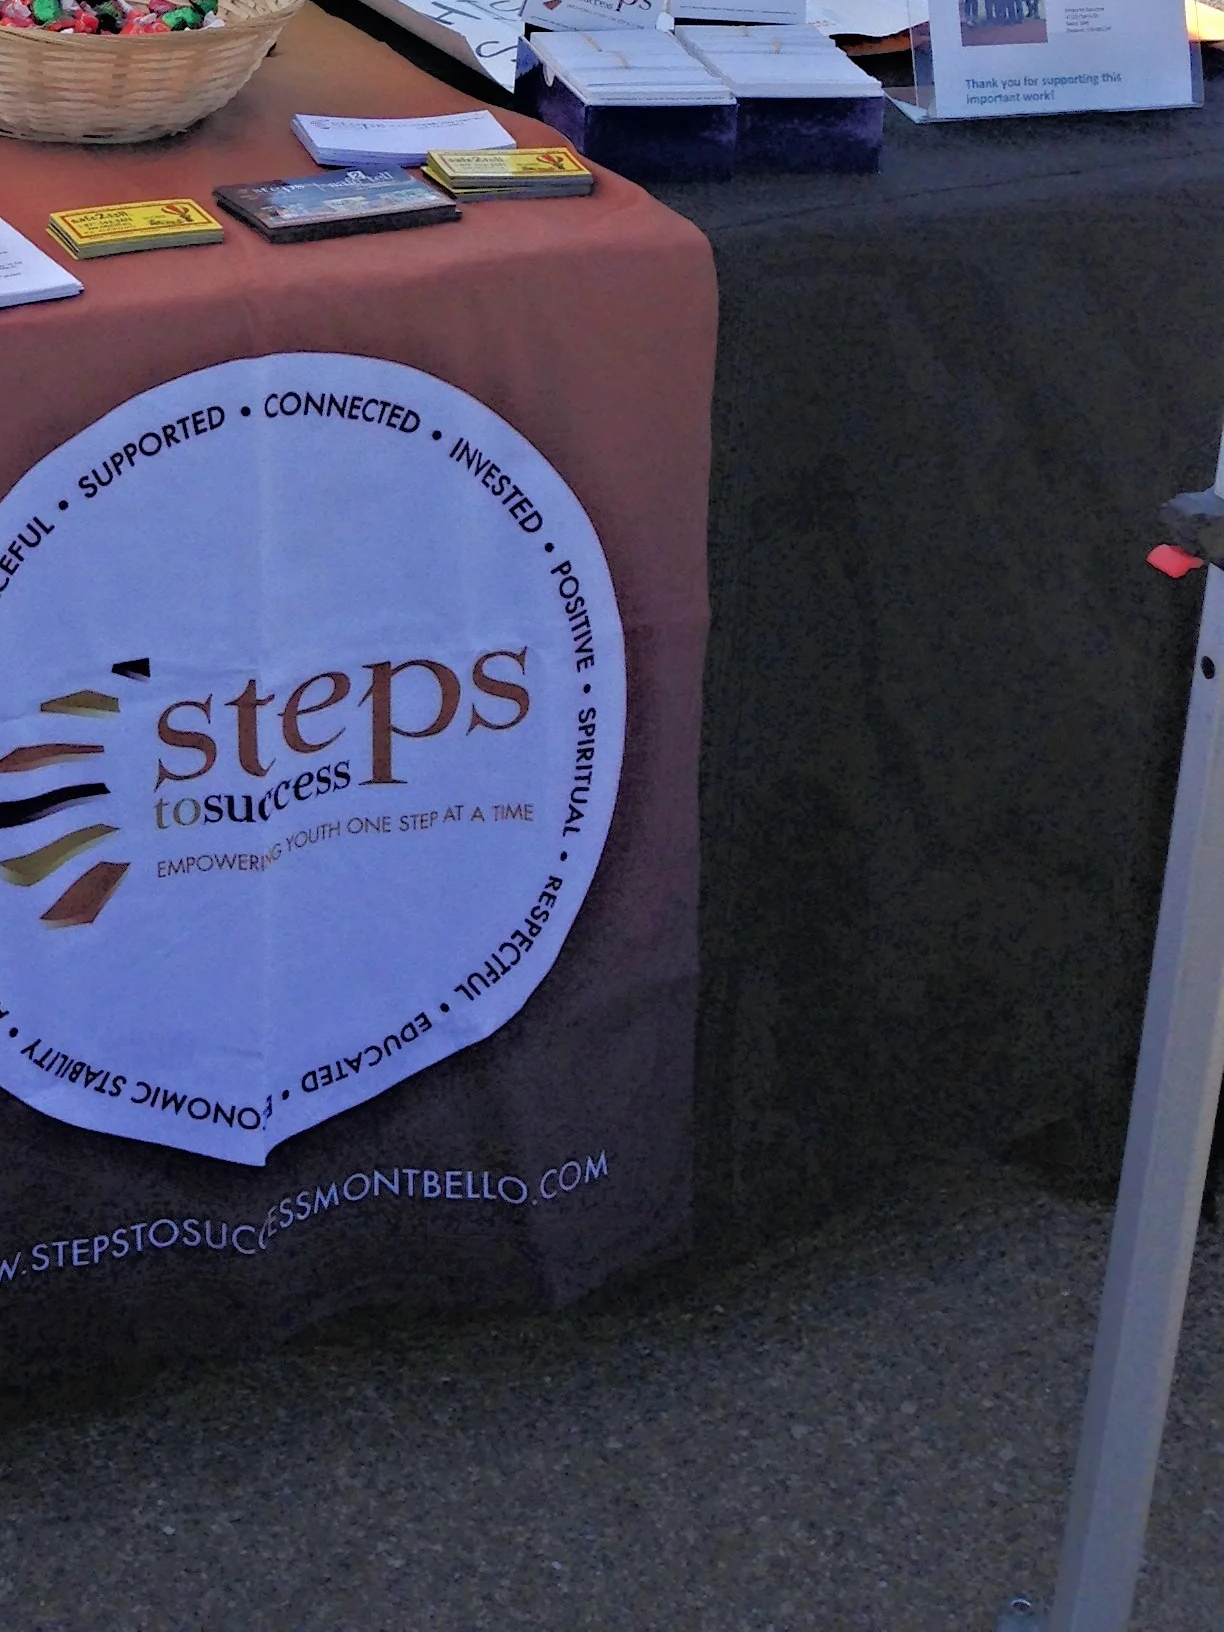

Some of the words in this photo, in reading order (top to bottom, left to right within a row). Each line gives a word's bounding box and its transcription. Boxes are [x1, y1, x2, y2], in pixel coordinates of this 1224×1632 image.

[965, 78, 998, 90] Thank
[1001, 78, 1021, 90] you
[1024, 76, 1038, 87] for
[1042, 73, 1099, 87] supporting
[1101, 72, 1122, 83] this
[966, 92, 1021, 106] important
[1023, 89, 1055, 102] work!
[78, 404, 227, 501] SUPPORTED
[263, 391, 423, 435] CONNECTED
[450, 436, 545, 535] INVESTED
[550, 559, 597, 674] POSITIVE
[154, 646, 531, 792] steps
[564, 706, 598, 840] SPIRITUAL
[157, 843, 283, 878] EMPOWERING
[285, 821, 342, 853] YOUTH
[346, 815, 392, 835] ONE
[398, 810, 439, 832] STEP
[442, 804, 465, 822] AT
[470, 806, 486, 822] A
[491, 803, 536, 822] TIME
[454, 873, 562, 1004] RESPECTFUL
[29, 1038, 129, 1101] STABILITY
[300, 1010, 433, 1095] EDUCATED
[130, 1079, 274, 1134] ONOMIC
